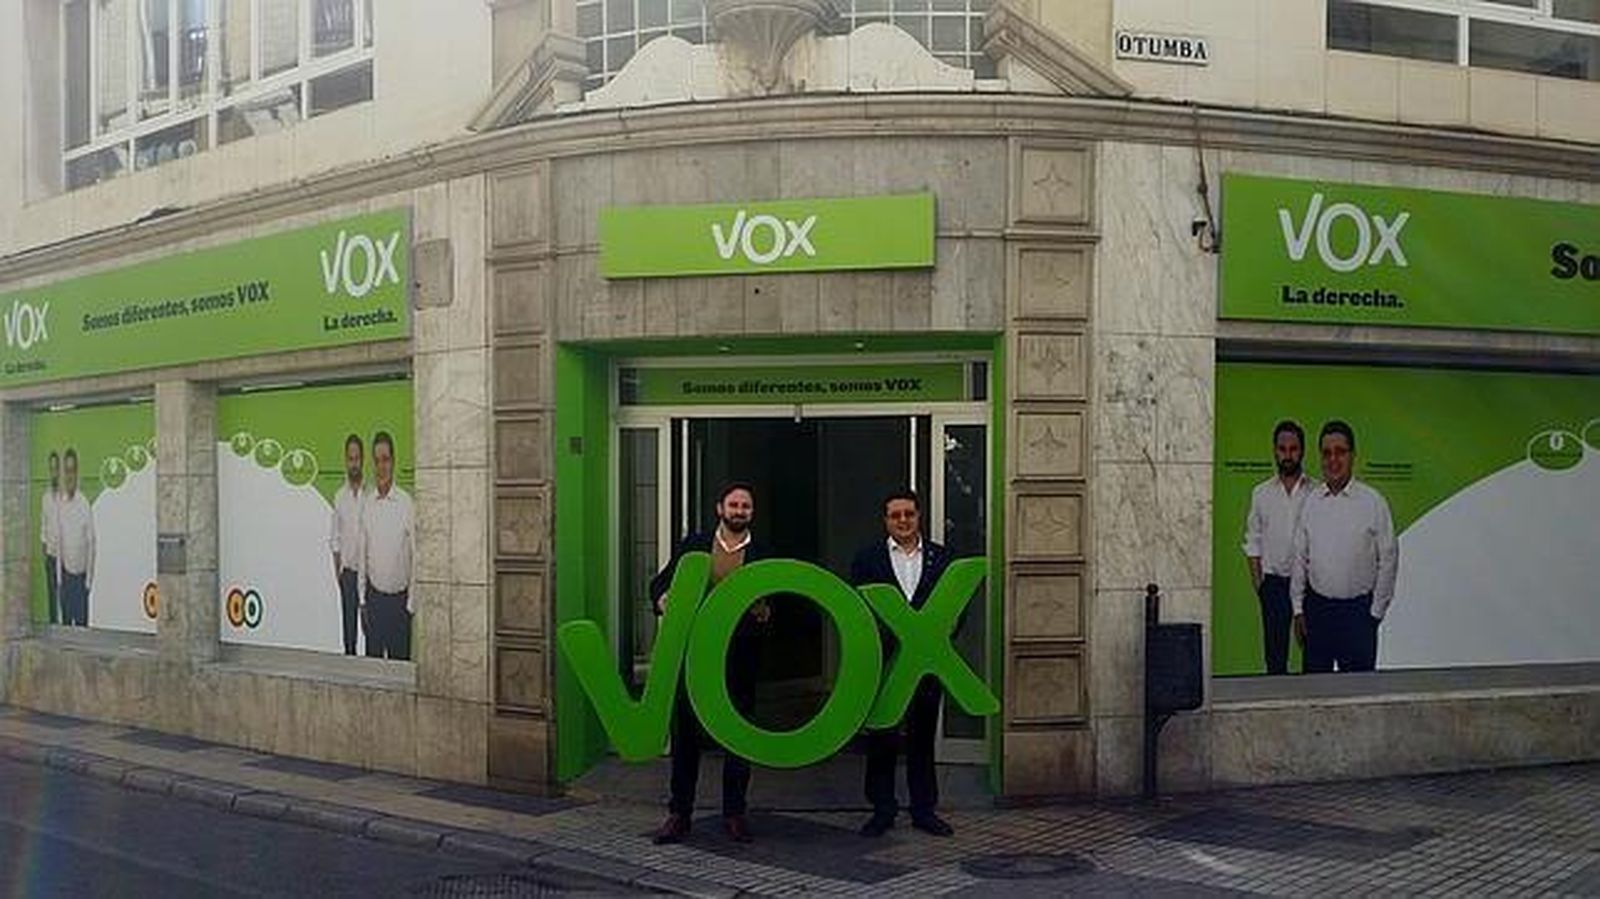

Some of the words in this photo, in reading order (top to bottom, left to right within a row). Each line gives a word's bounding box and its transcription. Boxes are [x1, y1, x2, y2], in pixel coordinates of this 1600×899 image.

[1117, 33, 1208, 61] OTUMBA
[711, 210, 818, 264] VOX
[1278, 193, 1410, 273] VOX
[320, 230, 400, 298] VOX
[82, 313, 120, 332] Somos
[191, 291, 235, 313] somos
[236, 281, 270, 305] VOX
[1282, 285, 1308, 303] La
[1312, 287, 1404, 308] derecha.
[4, 300, 49, 350] VOX
[324, 316, 339, 331] La
[682, 380, 735, 395] Somos
[829, 380, 882, 393] somos
[884, 377, 921, 392] VOX
[558, 551, 1000, 768] VOX
